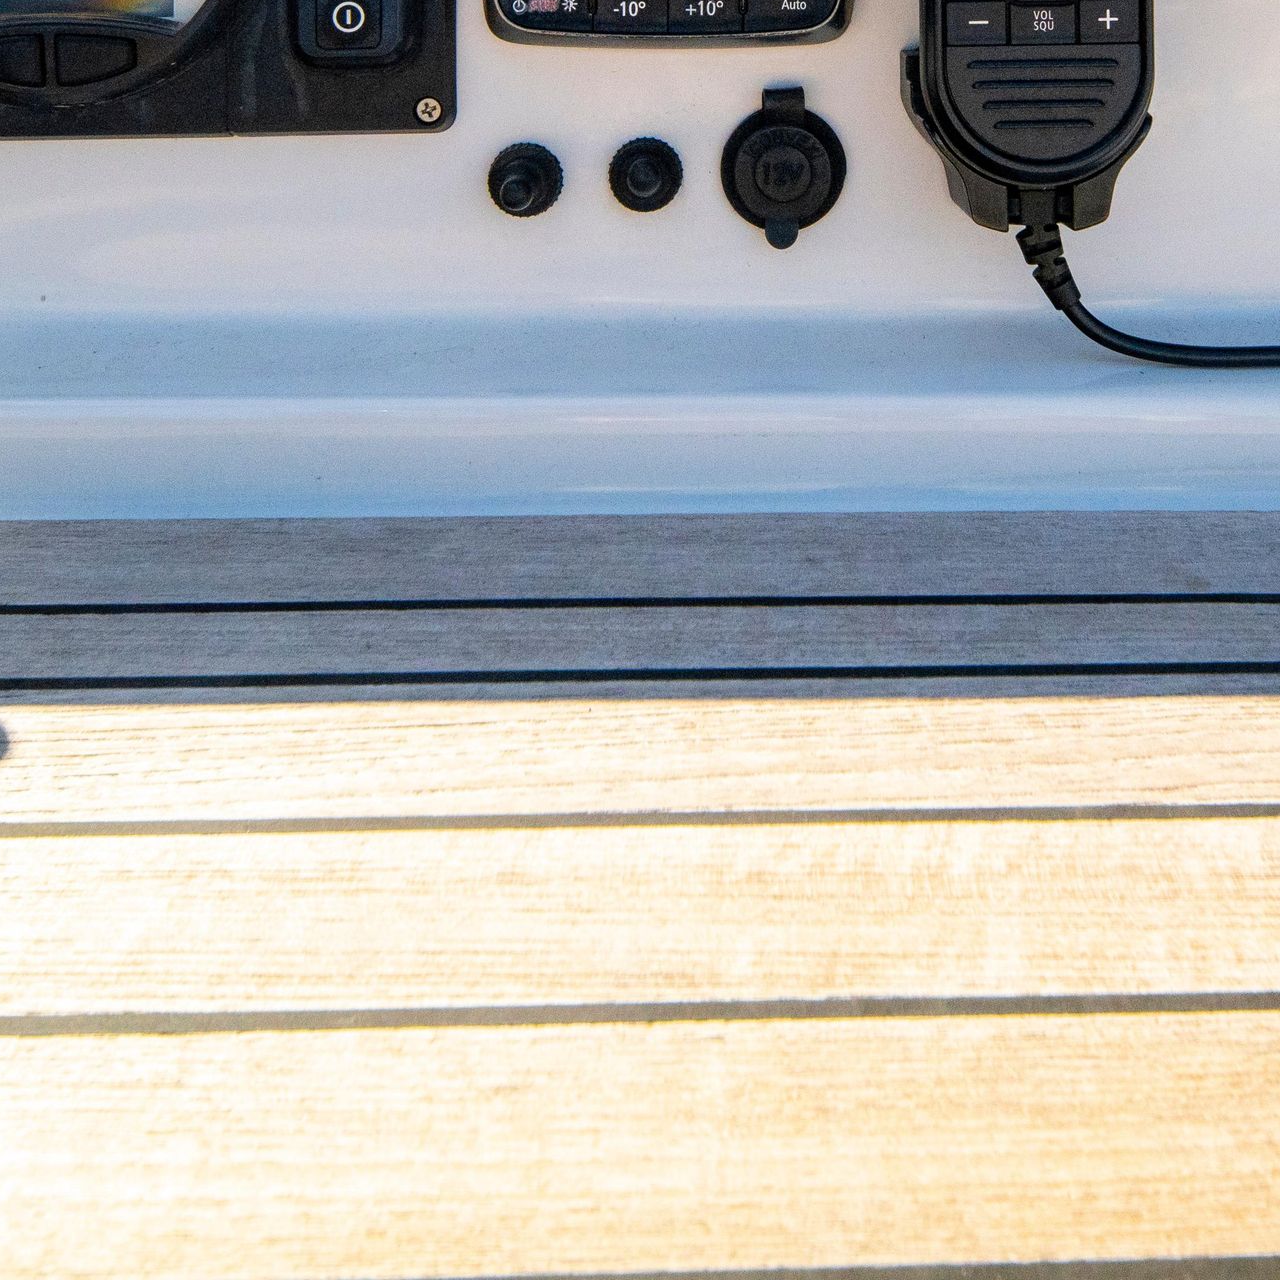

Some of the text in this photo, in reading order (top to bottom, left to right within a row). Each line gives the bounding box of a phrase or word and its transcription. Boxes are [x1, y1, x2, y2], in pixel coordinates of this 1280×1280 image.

[781, 0, 807, 10] Auto
[1033, 10, 1053, 20] VOL
[1033, 21, 1054, 31] SQU
[762, 160, 805, 187] 12V
